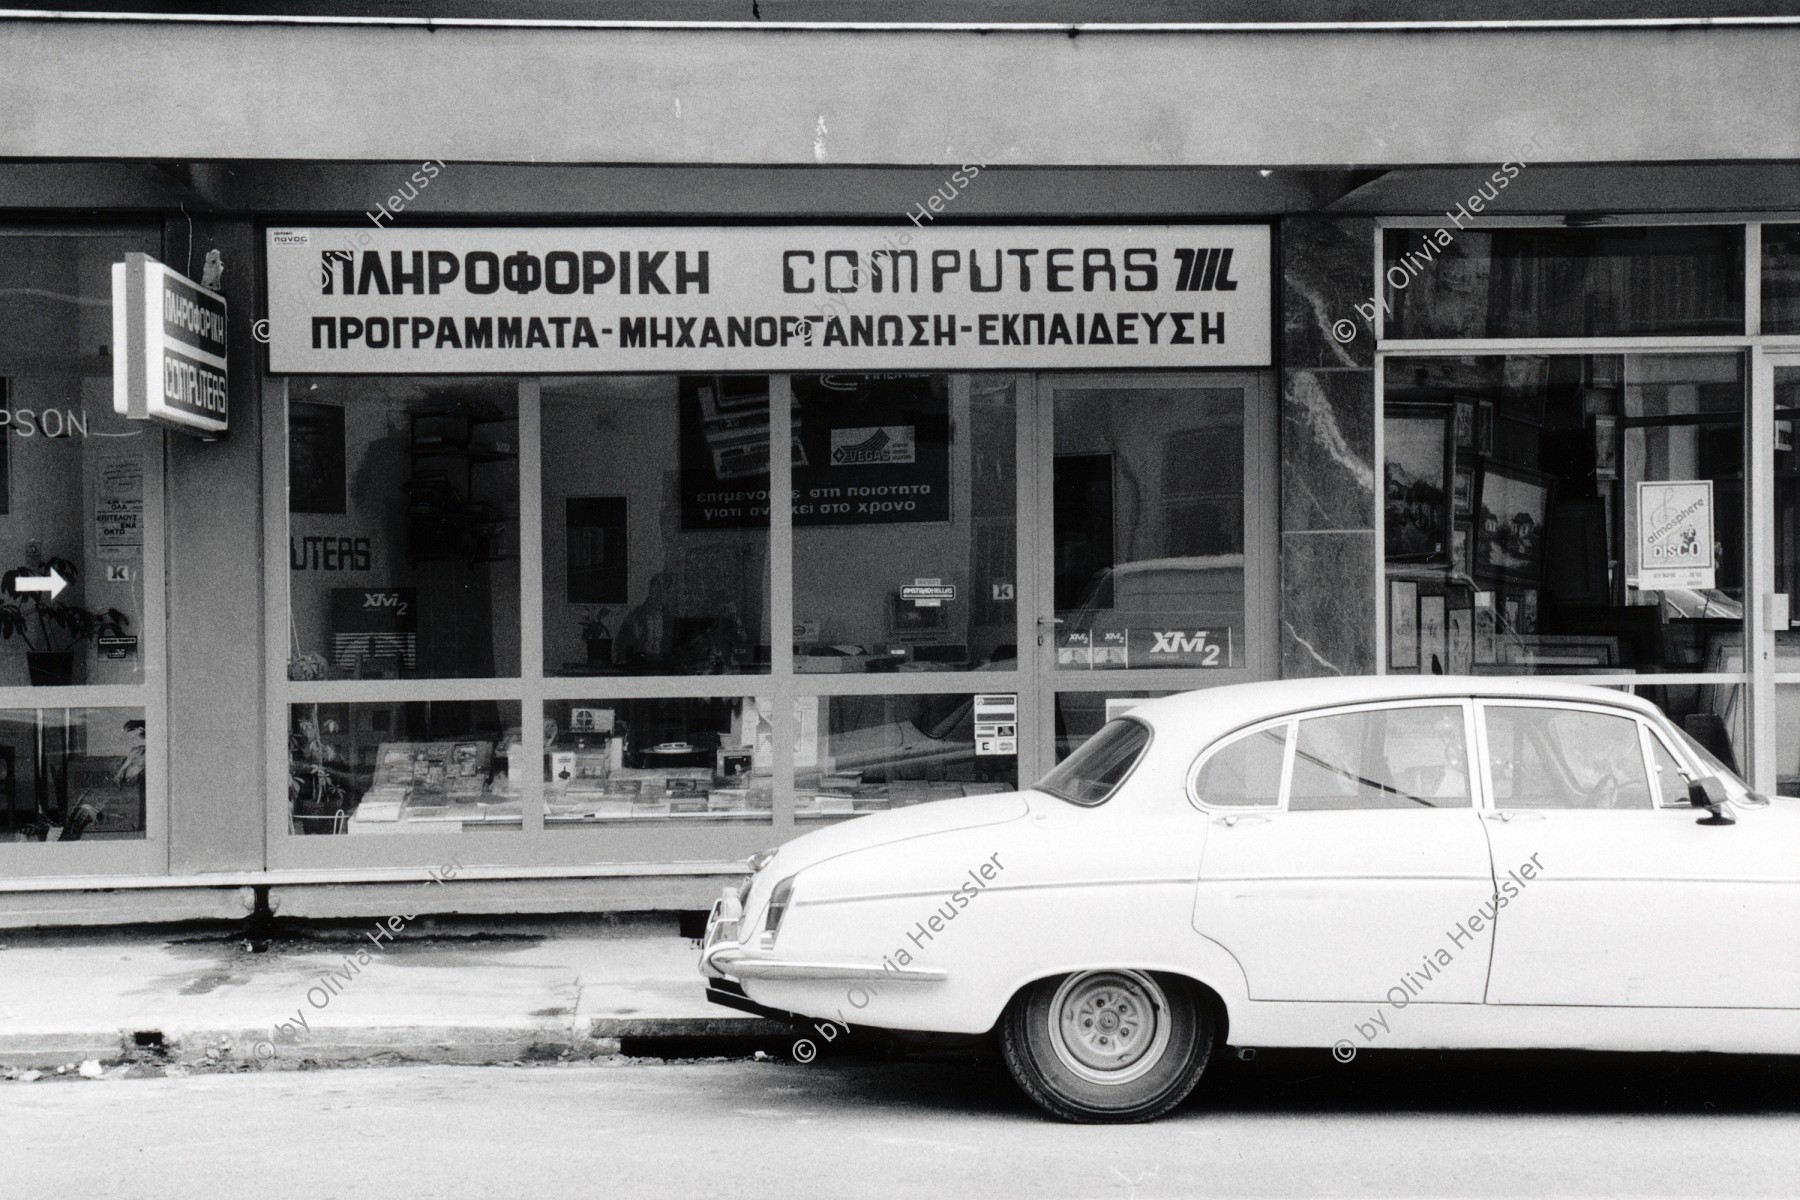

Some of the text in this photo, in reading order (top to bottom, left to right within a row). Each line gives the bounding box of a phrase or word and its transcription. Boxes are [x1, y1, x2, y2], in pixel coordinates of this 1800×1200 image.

[322, 250, 710, 295] ΠΛΗΡΟΦΟΡΙΚΗ
[783, 248, 1158, 293] COMPUTERS
[165, 288, 224, 344] ΠΛΗΡΟΦΟΡΙΚΗ
[164, 356, 226, 414] COMPUTERS
[290, 536, 370, 571] UTERS
[1653, 541, 1702, 558] DISCO
